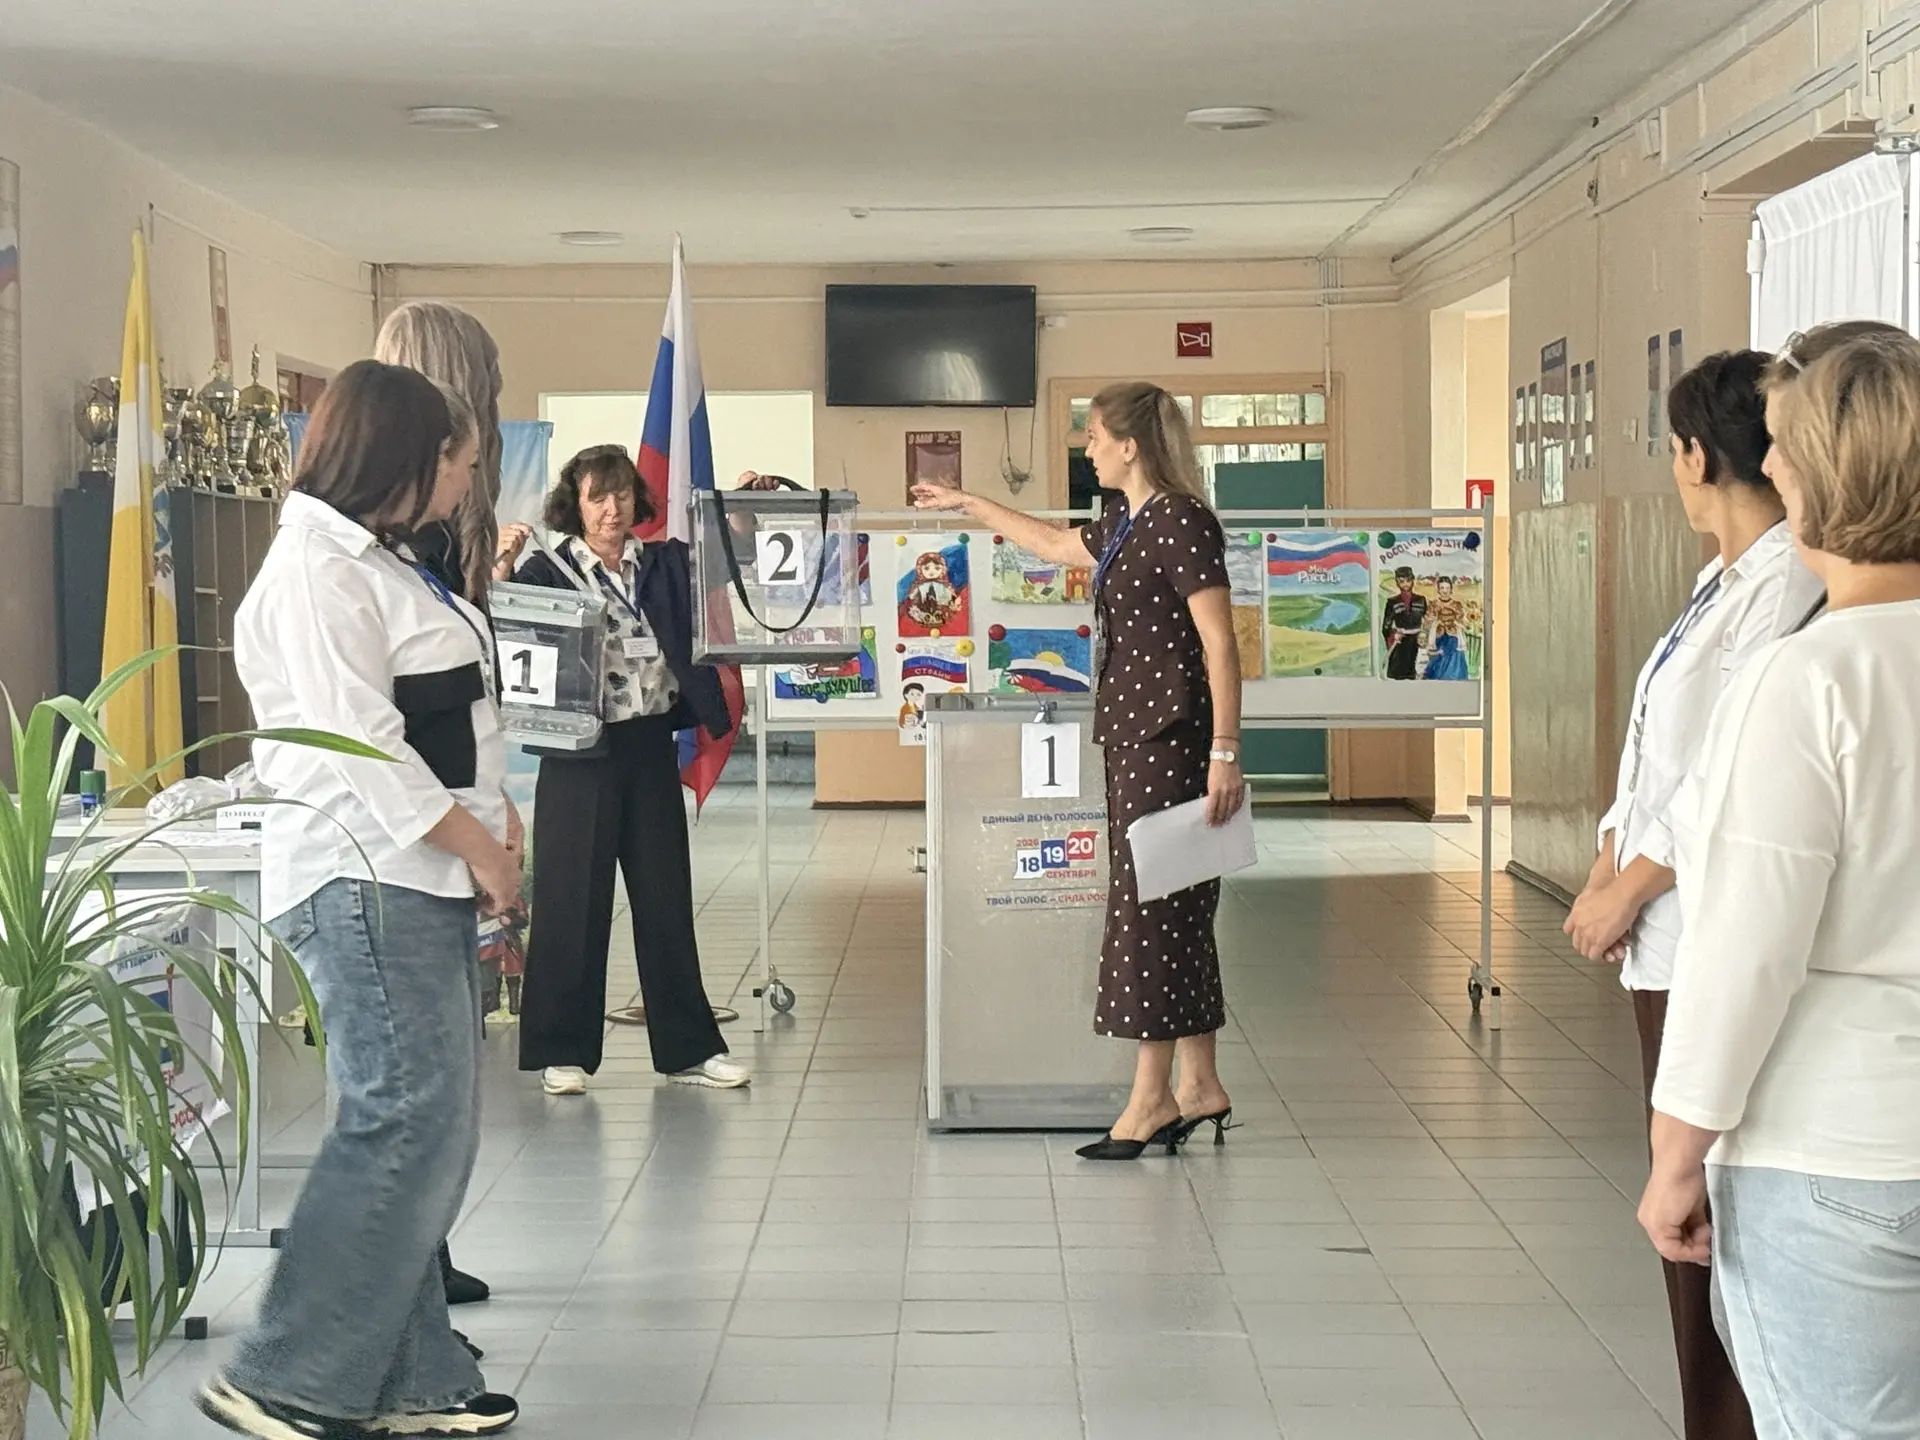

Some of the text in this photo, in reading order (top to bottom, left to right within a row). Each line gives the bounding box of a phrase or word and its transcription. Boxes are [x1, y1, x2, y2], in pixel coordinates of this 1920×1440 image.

[766, 532, 798, 582] 2
[510, 649, 539, 695] 1
[1041, 735, 1061, 787] 1
[982, 813, 1025, 824] ЕДИНЫЙ
[1027, 813, 1053, 823] ДЕНЬ
[1043, 846, 1065, 863] 19
[1068, 837, 1093, 855] 20
[1020, 857, 1040, 873] 18
[1046, 869, 1097, 879] СЕНТЯБРЯ
[986, 896, 1012, 906] ТВОЙ
[1014, 895, 1047, 905] ГОЛОС
[1058, 894, 1086, 904] СИЛА
